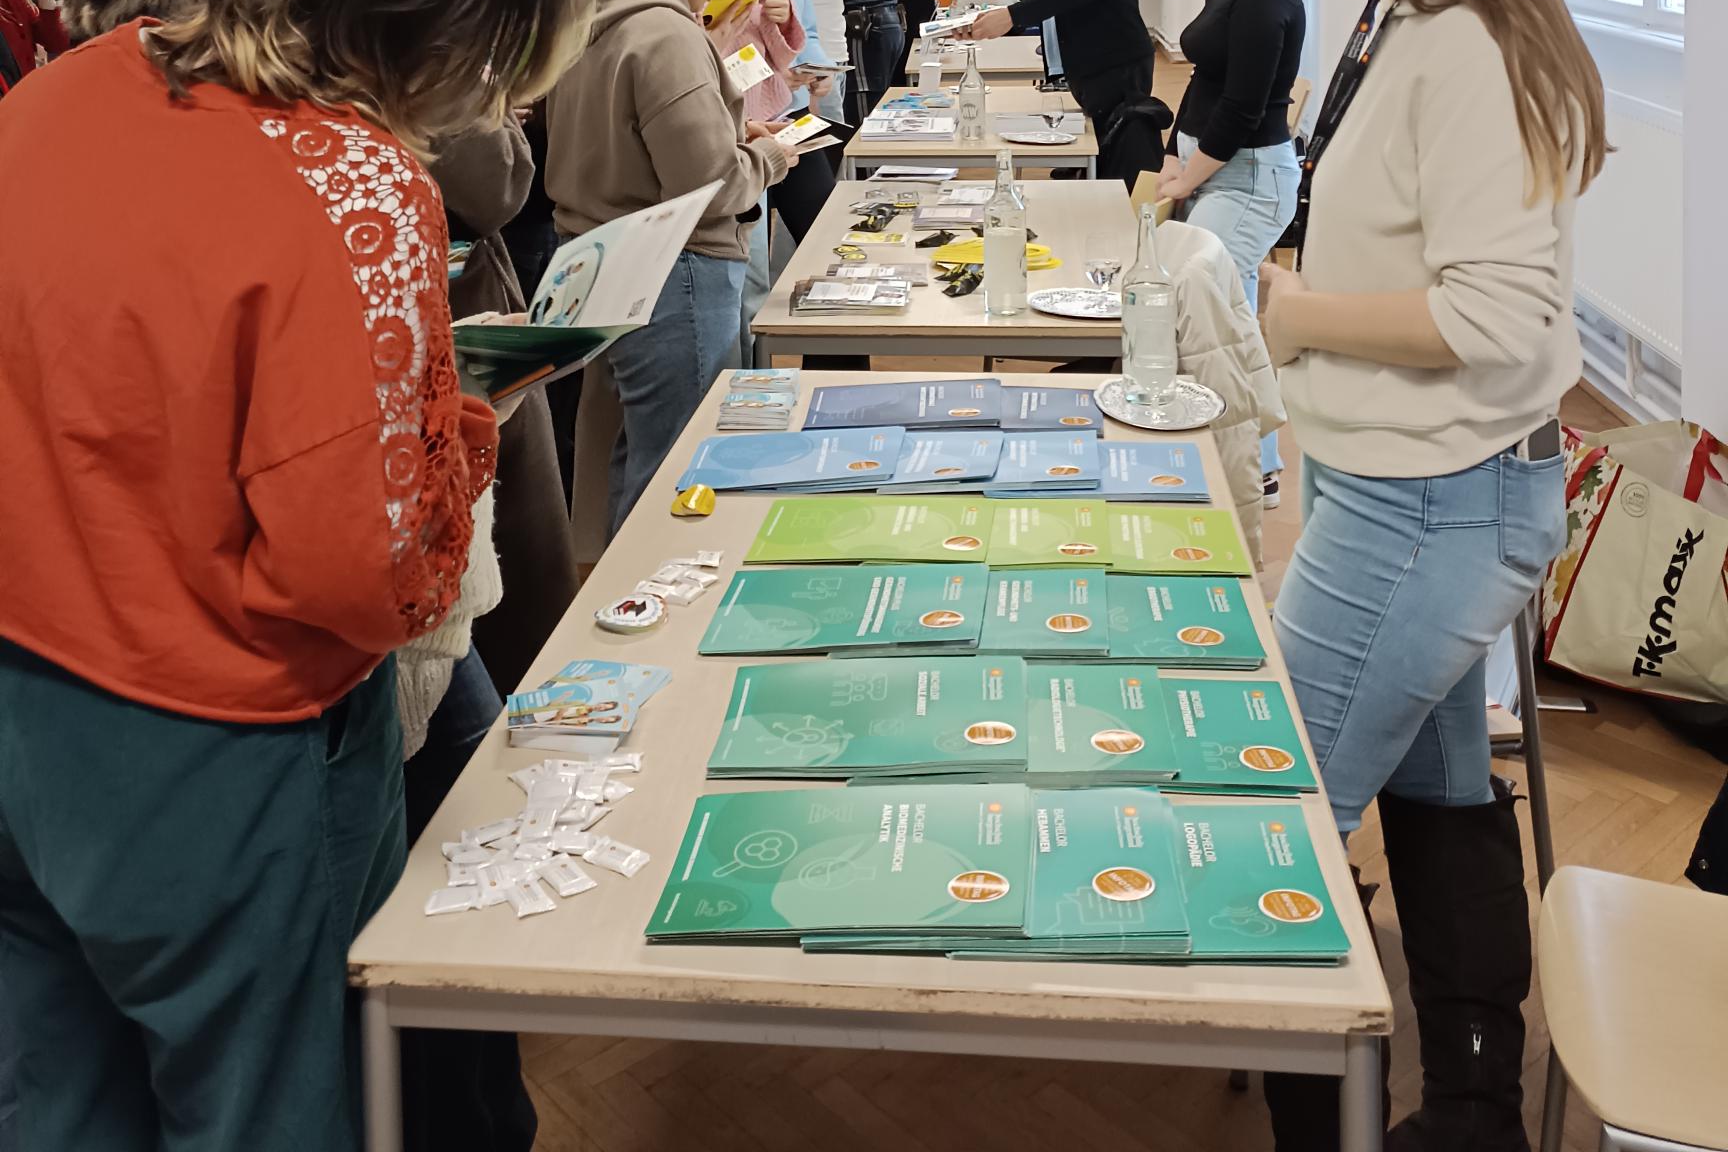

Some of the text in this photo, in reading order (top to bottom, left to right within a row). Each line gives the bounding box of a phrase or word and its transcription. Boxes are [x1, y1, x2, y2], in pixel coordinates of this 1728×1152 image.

[878, 804, 894, 844] ANALYTIK
[891, 803, 910, 872] BIOMEDIZINISCHE
[912, 802, 926, 844] BACHELOR
[1036, 808, 1052, 853] HEBAMMEN
[1053, 808, 1068, 848] BACHELOR
[1198, 822, 1217, 862] BACHELOR
[1183, 822, 1204, 868] LOGOPÄDIE
